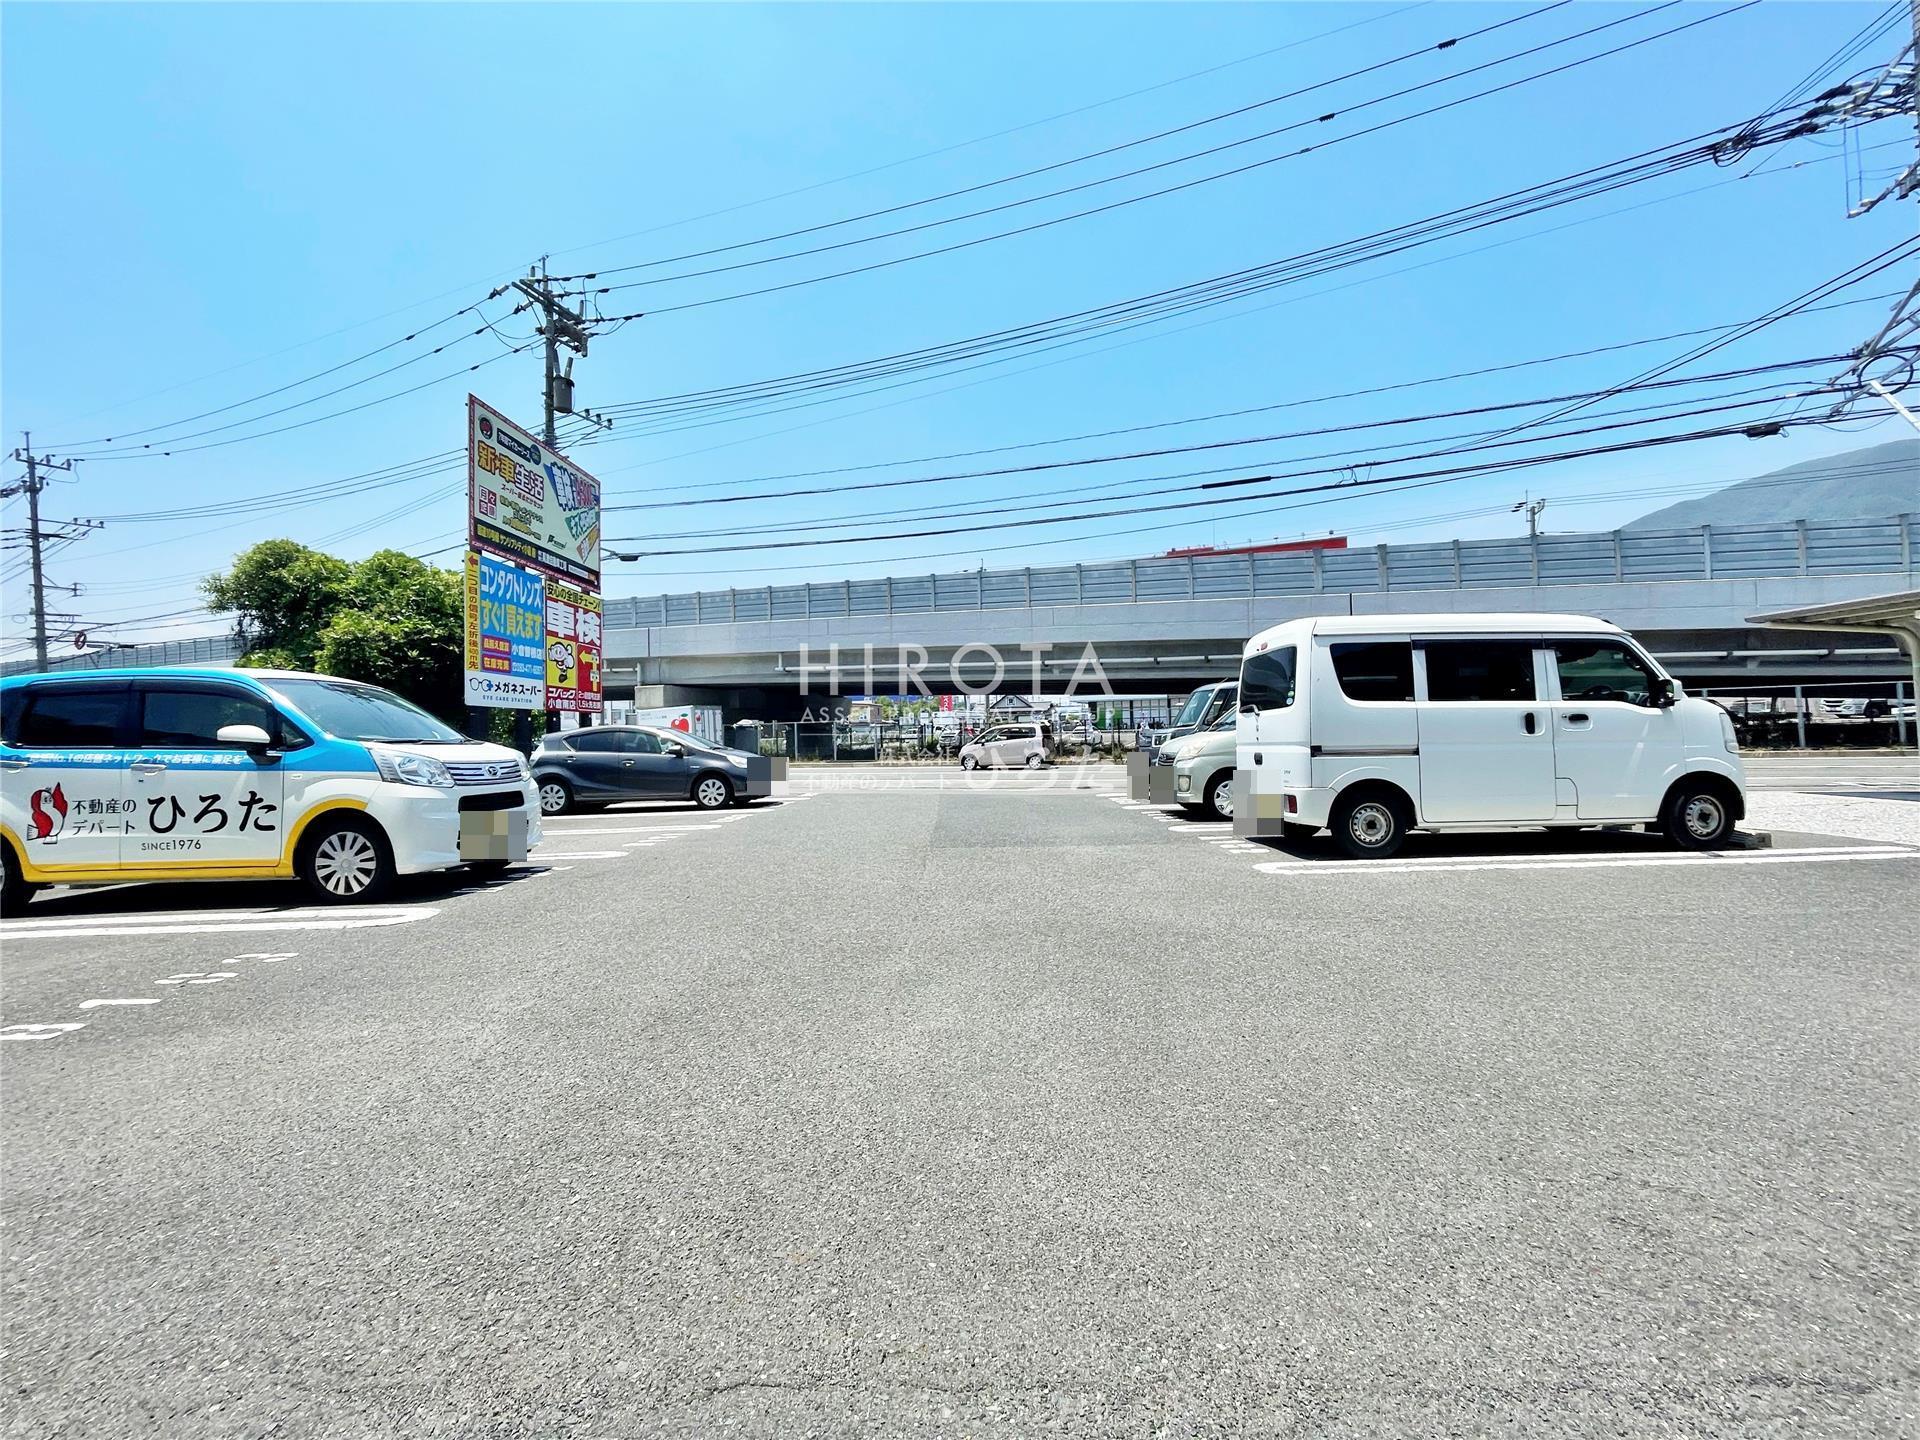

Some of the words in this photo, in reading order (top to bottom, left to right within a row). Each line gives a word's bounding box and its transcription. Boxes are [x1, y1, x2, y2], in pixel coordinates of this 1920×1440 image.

[481, 564, 542, 609] コンタクトレンズ
[547, 600, 600, 645] 車検
[495, 682, 542, 696] メガネスーパー
[548, 688, 575, 699] コバック
[72, 799, 137, 815] 不動産の
[147, 790, 278, 834] ひろた
[72, 819, 137, 836] デパート
